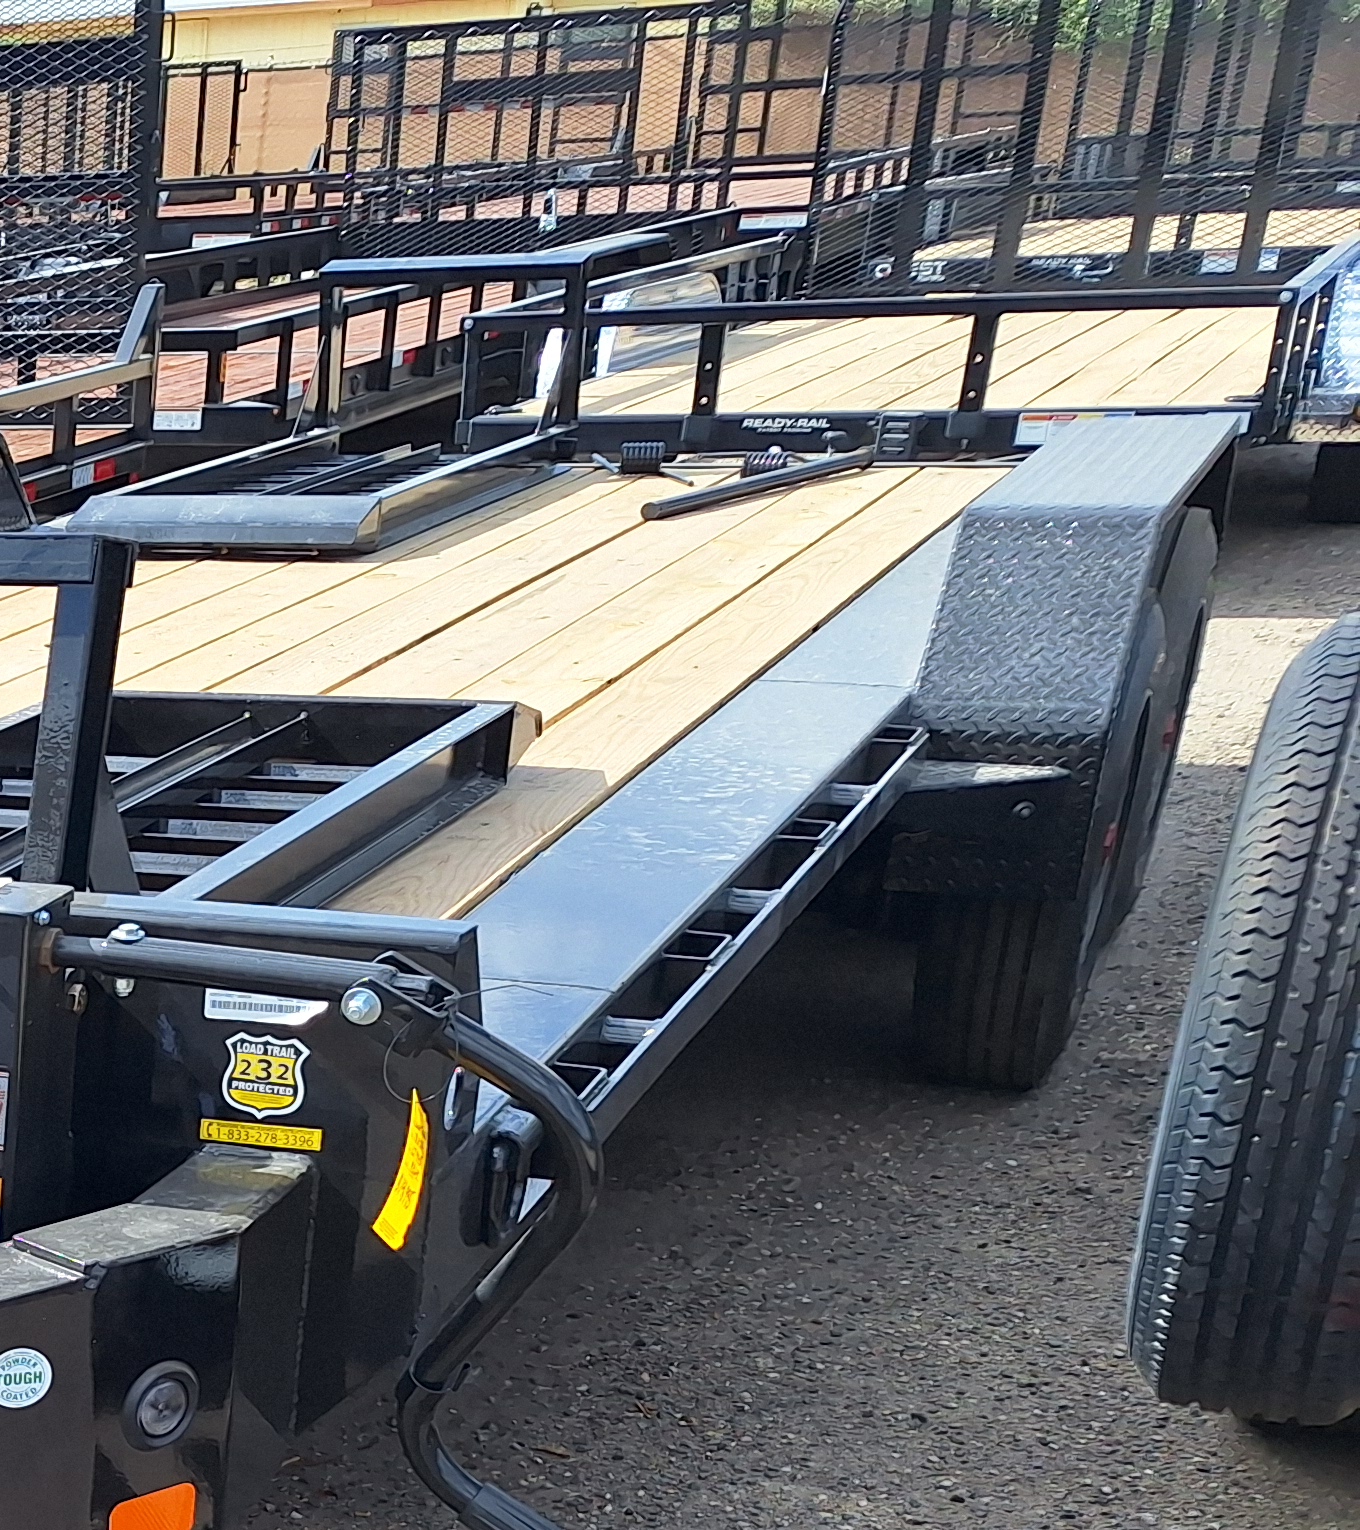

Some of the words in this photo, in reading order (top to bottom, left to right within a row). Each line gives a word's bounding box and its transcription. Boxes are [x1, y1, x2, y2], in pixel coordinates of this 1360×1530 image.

[236, 1041, 265, 1054] LOAD
[266, 1045, 297, 1058] TRAIL
[239, 1059, 290, 1082] 232
[231, 1081, 294, 1096] PROTECTED
[215, 1126, 314, 1147] 1-833-278-3396
[0, 1356, 39, 1372] POWDER
[0, 1386, 38, 1401] COATED
